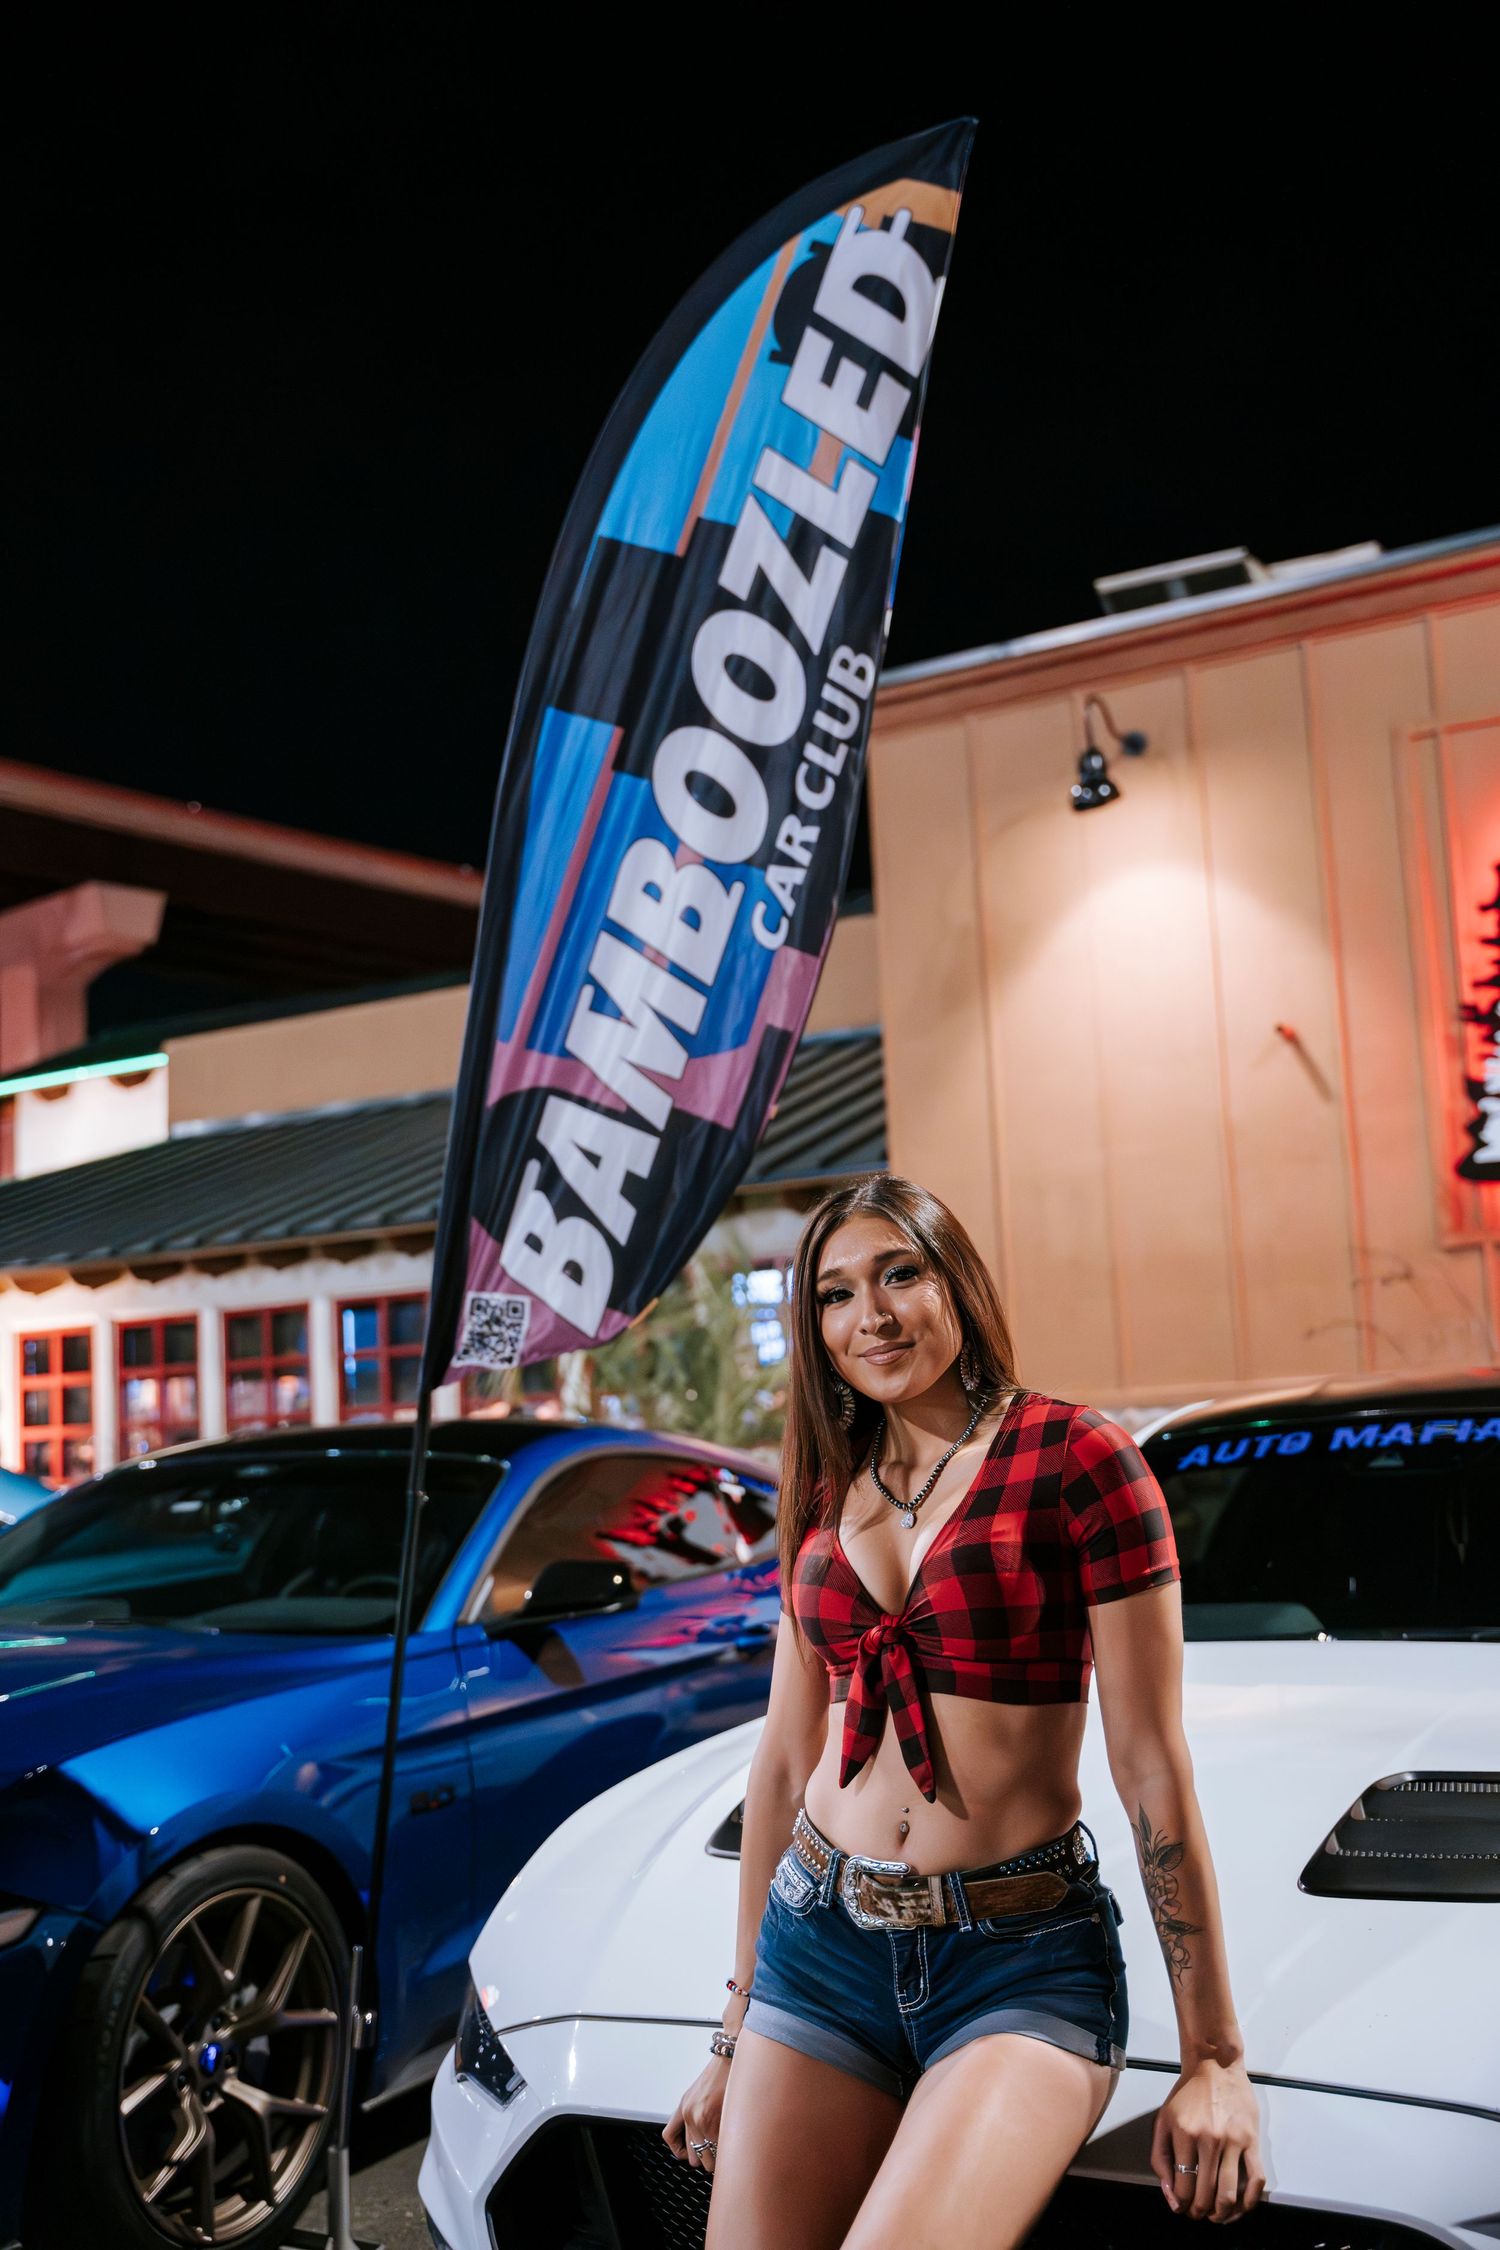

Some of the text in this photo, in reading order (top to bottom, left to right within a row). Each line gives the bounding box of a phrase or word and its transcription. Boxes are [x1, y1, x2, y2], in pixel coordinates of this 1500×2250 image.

[500, 203, 945, 1339] BAMBOOZLED
[752, 644, 876, 950] CAR CLUB
[1177, 1417, 1500, 1470] AUTO MAFIA
